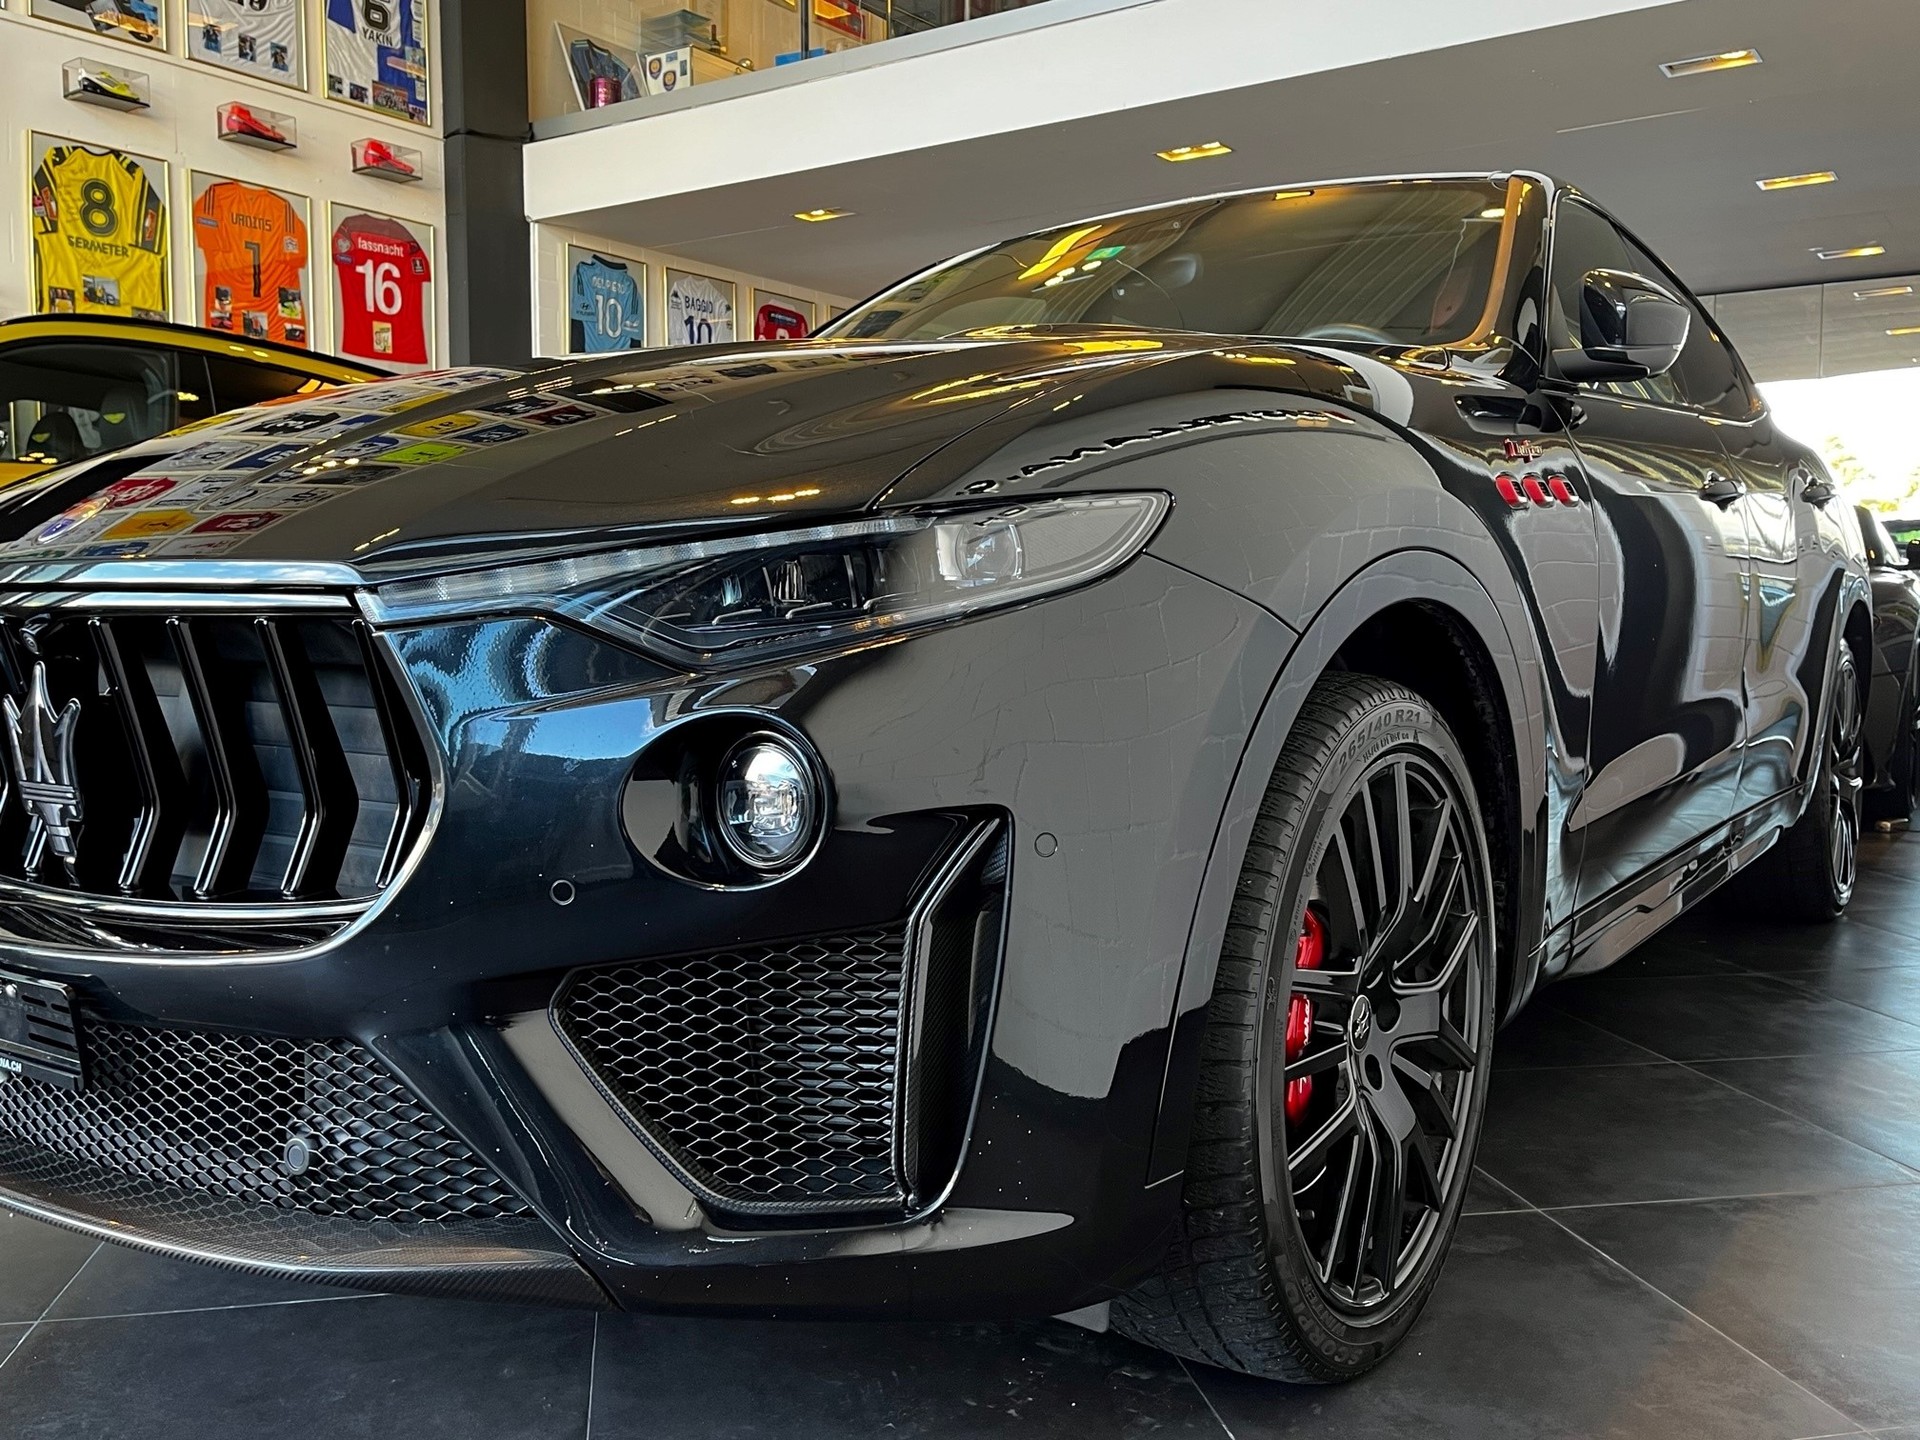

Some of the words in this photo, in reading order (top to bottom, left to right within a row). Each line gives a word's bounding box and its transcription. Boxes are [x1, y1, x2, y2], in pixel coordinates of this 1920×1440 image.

[361, 26, 393, 47] YAKIN
[80, 177, 118, 237] 8
[244, 240, 261, 298] 1
[355, 258, 402, 316] 16
[595, 294, 622, 339] 10
[684, 294, 714, 314] BAGGIO
[1395, 708, 1422, 724] R21
